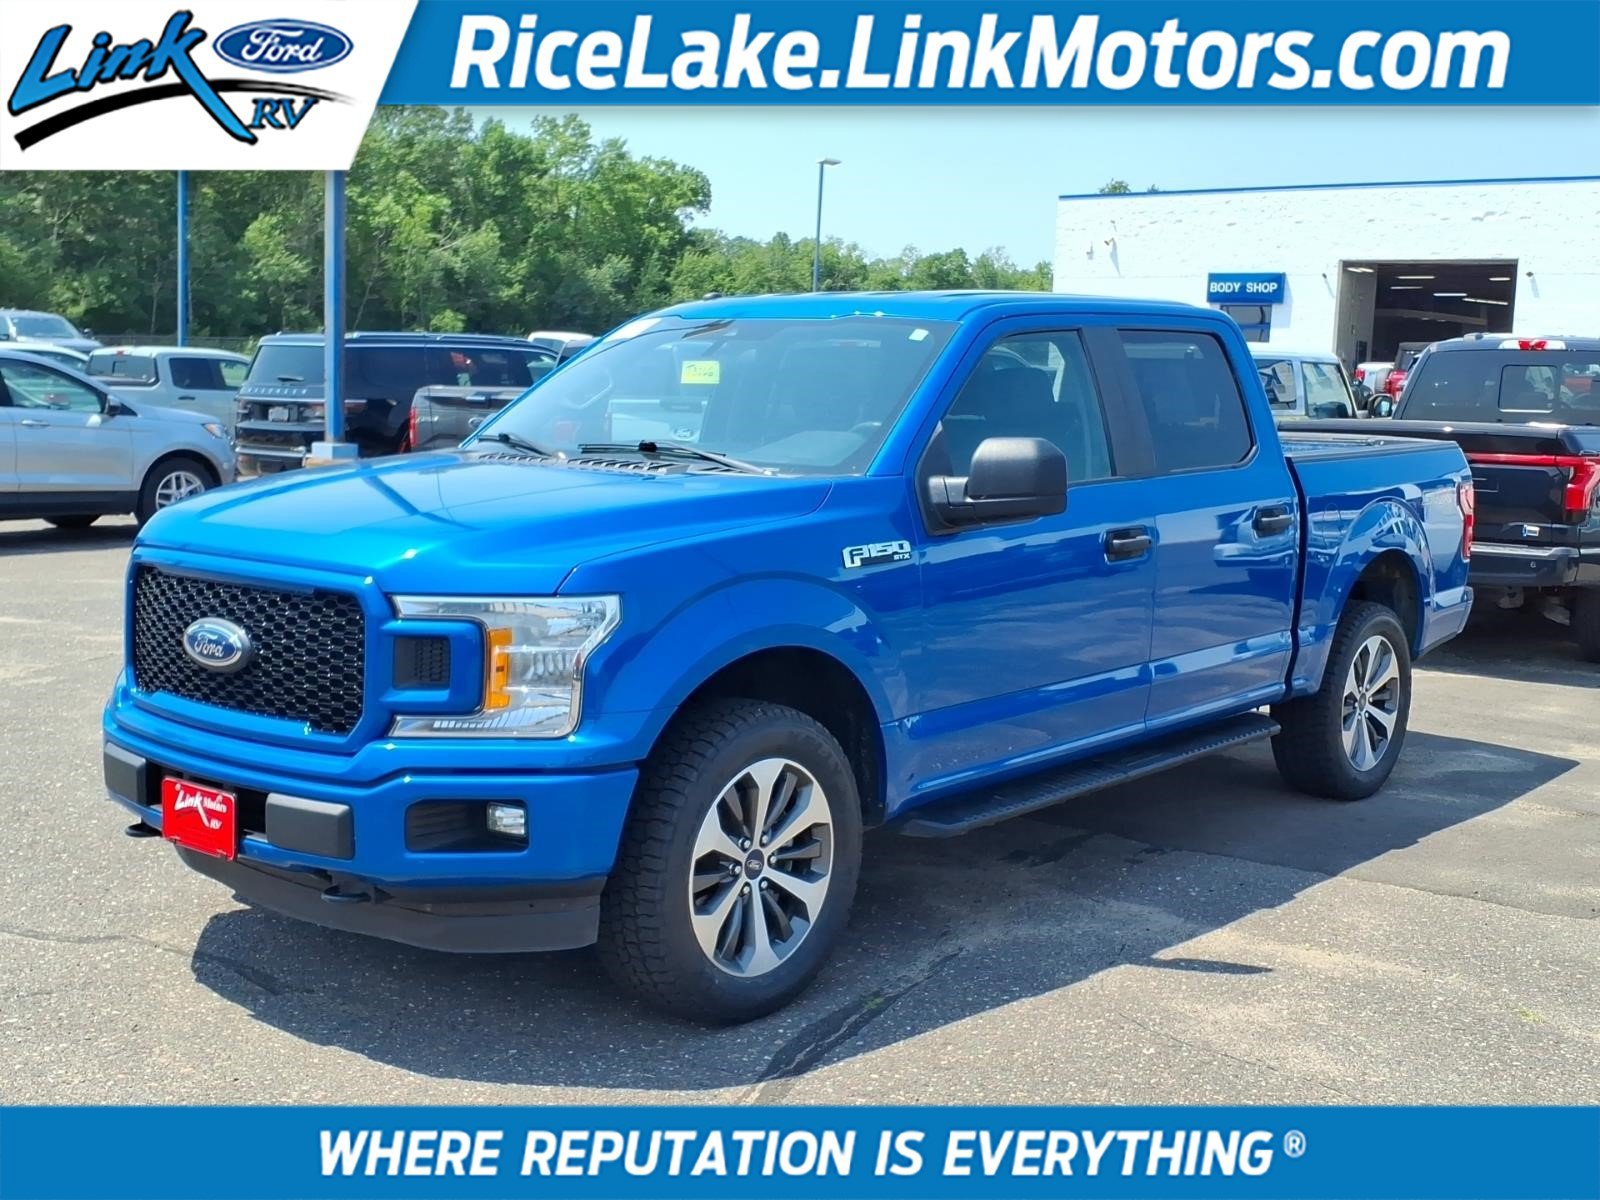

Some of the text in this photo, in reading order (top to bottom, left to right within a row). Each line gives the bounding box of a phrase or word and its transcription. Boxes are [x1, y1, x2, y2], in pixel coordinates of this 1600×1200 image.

[1209, 282, 1278, 293] BODY SHOP
[194, 631, 225, 657] Ford
[174, 790, 210, 828] Link
